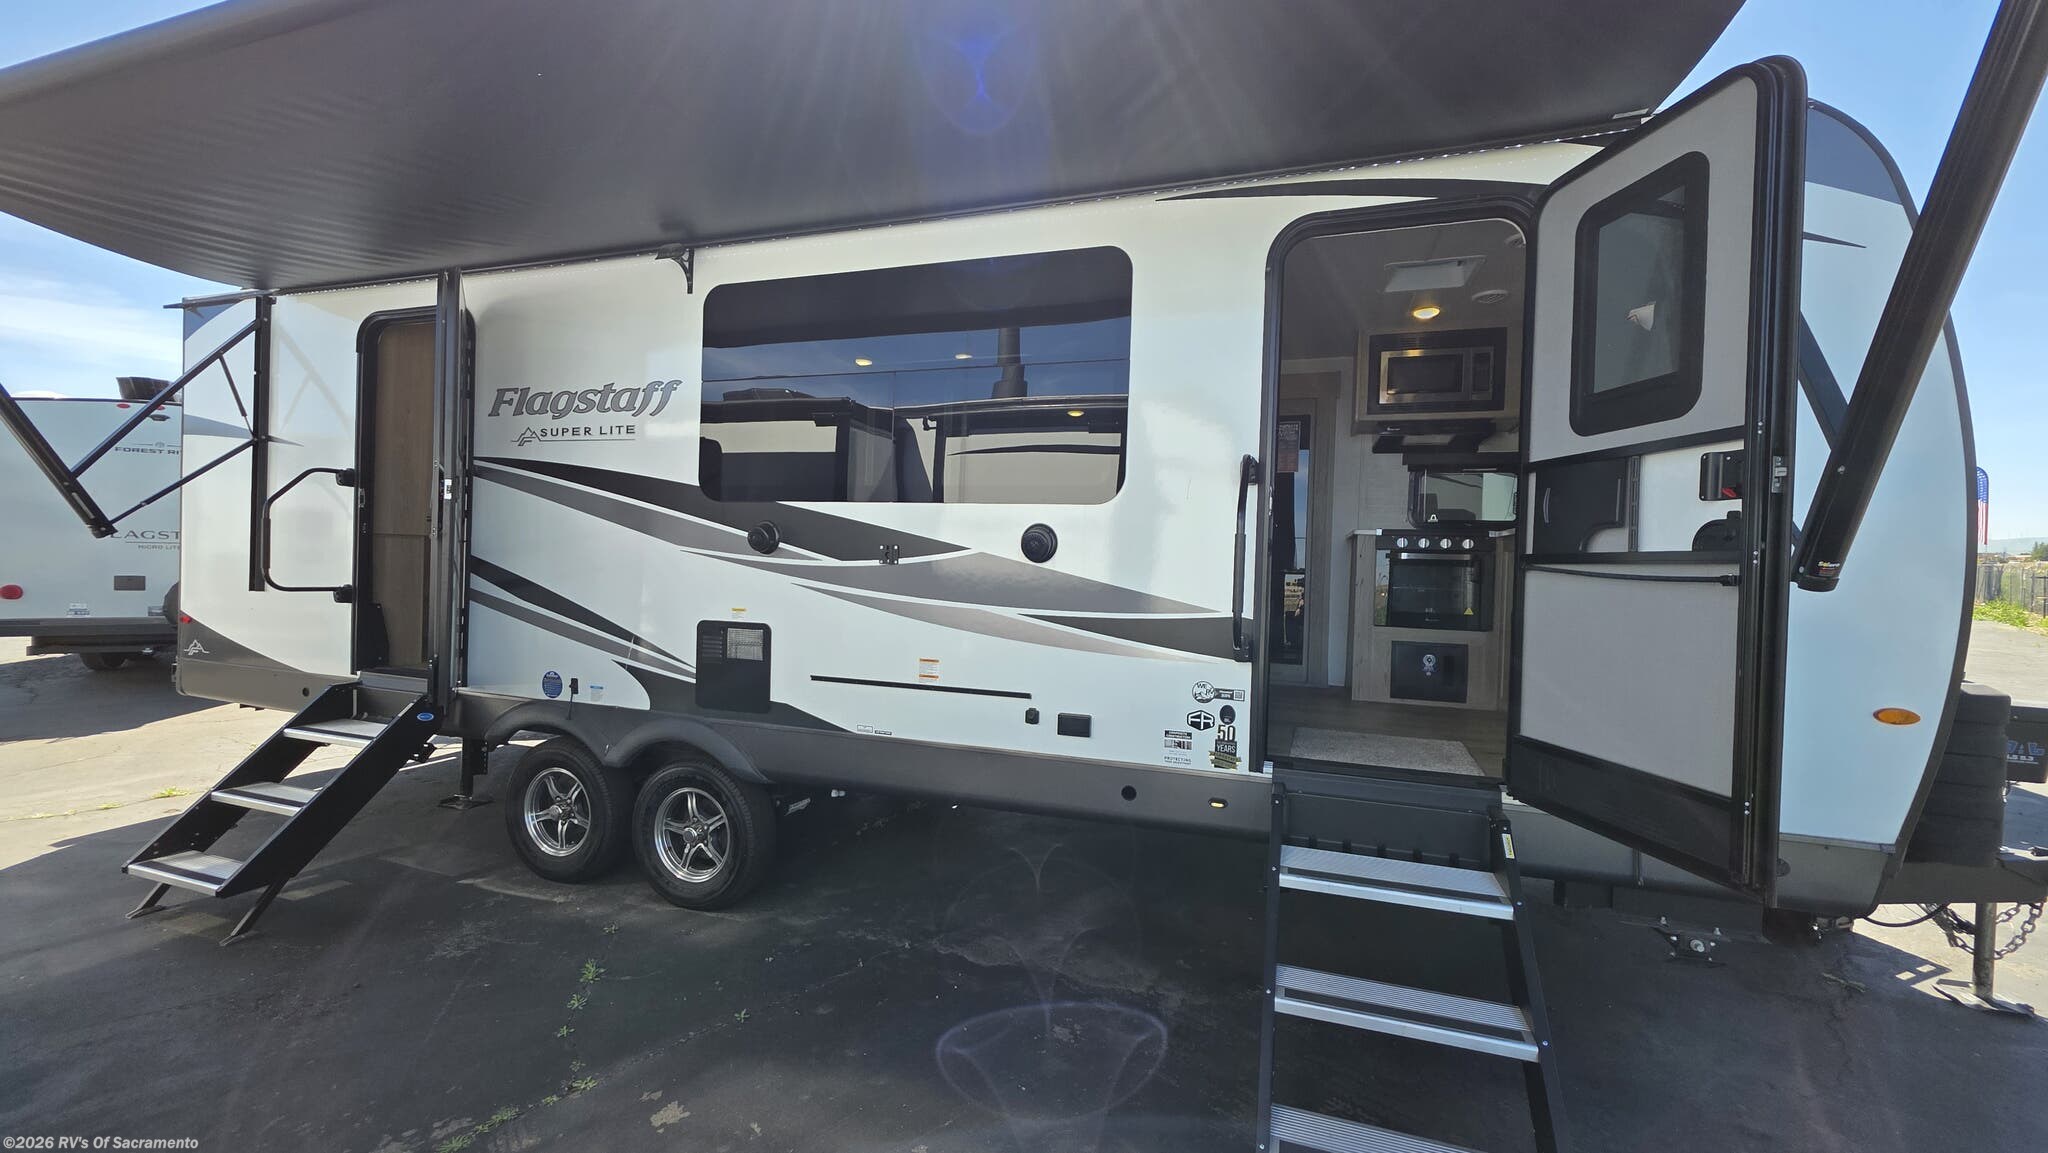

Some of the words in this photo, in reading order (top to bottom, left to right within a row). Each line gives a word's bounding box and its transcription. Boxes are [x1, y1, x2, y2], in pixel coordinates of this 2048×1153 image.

[488, 380, 683, 420] Flagstaff
[540, 427, 592, 437] SUPER
[599, 425, 636, 435] LITE
[1217, 724, 1236, 741] 50
[1216, 743, 1236, 754] YEARS
